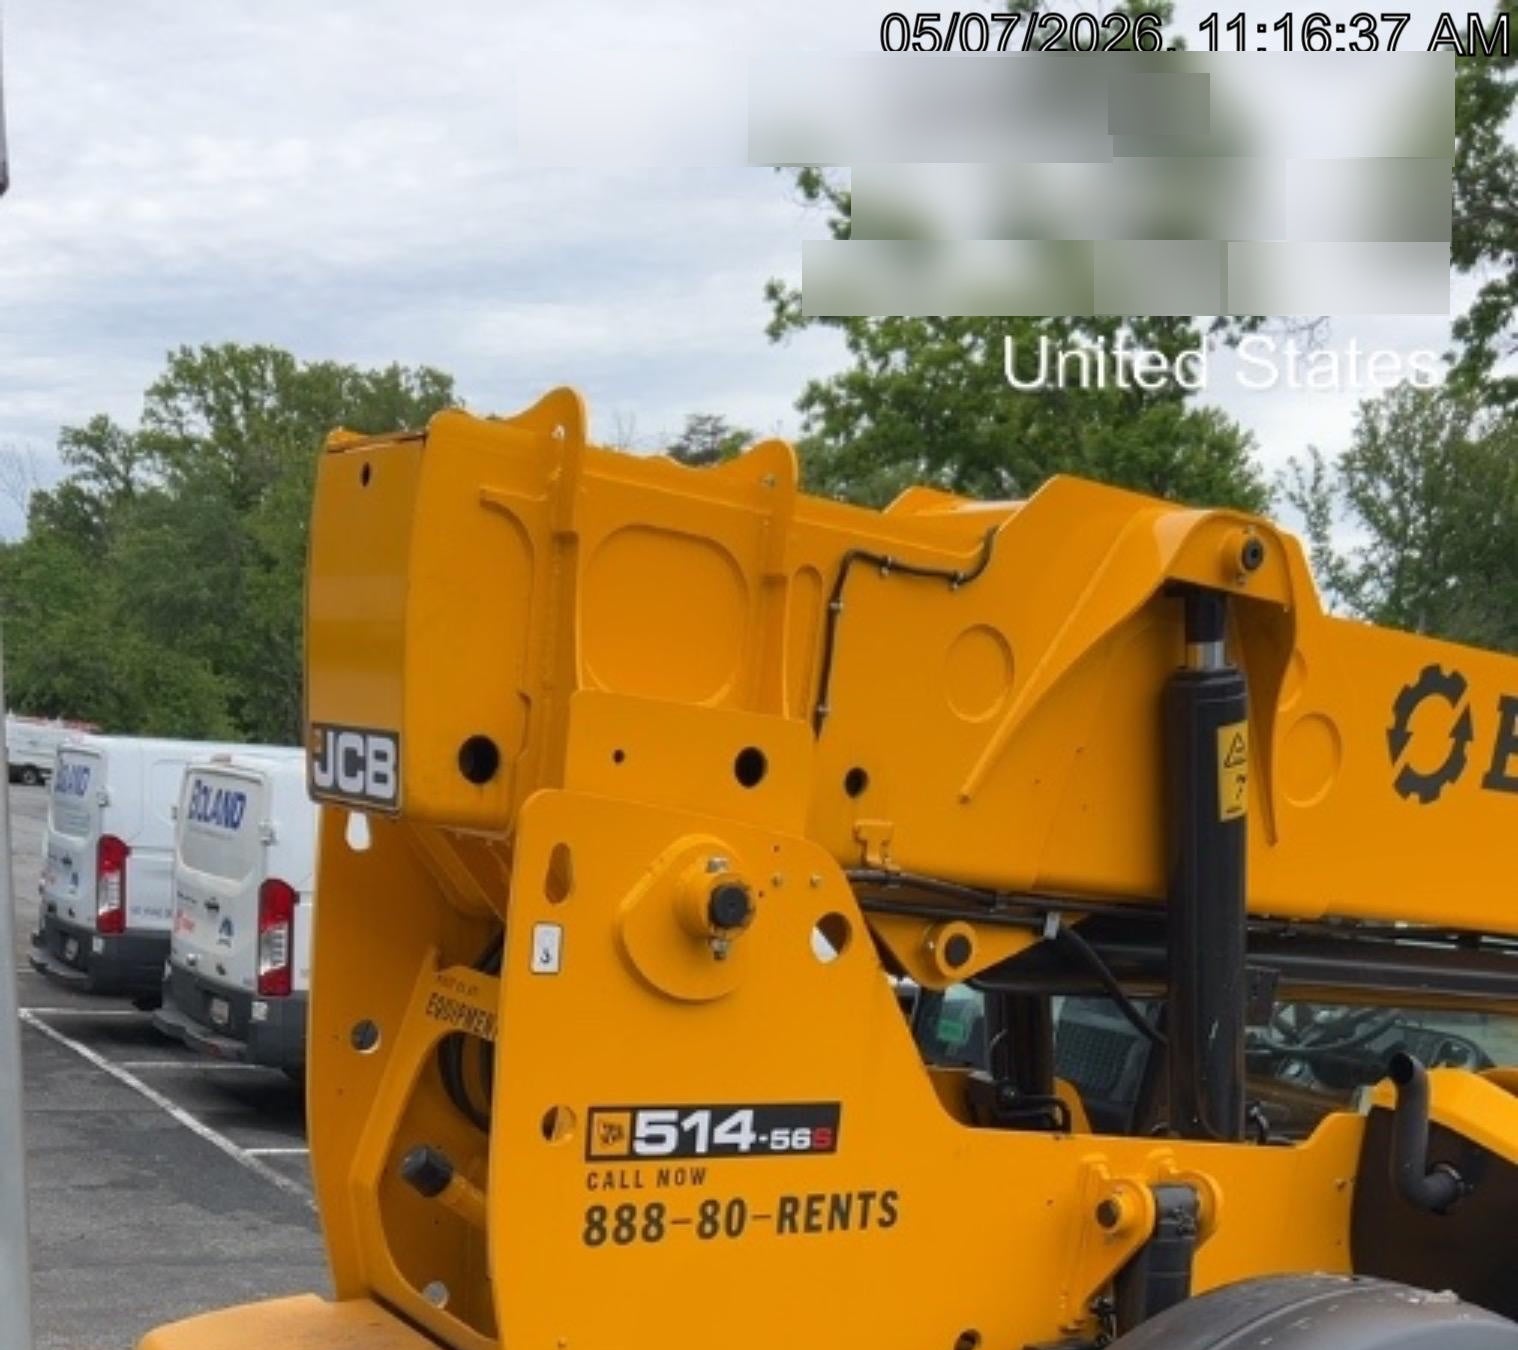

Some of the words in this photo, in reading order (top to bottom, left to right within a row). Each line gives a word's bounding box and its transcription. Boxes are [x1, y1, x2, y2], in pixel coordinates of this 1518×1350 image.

[313, 729, 396, 798] JCB
[426, 991, 498, 1040] EQUIPMEN
[586, 1169, 644, 1191] CALL
[656, 1167, 708, 1188] NOW
[583, 1190, 898, 1247] 888-80-RENTS
